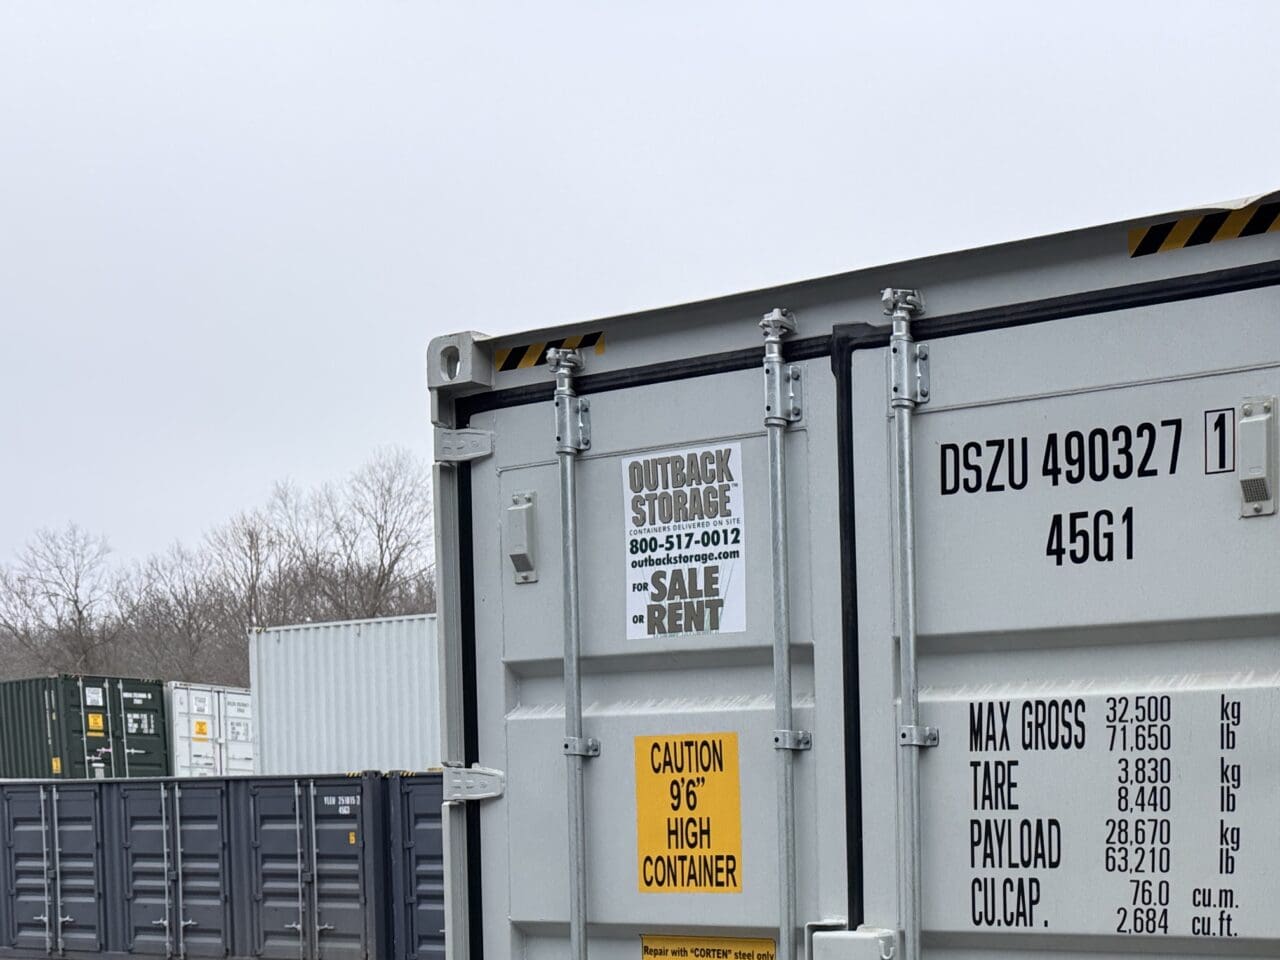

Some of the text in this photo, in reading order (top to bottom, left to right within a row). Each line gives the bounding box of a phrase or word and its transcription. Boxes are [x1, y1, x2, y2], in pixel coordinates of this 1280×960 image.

[940, 413, 1227, 496] DSZU 490327 1
[628, 448, 734, 494] OUTBACK
[631, 483, 732, 528] STORAGE
[629, 525, 671, 536] CONTAINERS
[673, 521, 710, 531] DELIVERED
[629, 528, 741, 555] 800-517-0012
[1046, 506, 1133, 566] 45G1
[631, 550, 740, 568] outbackstorage.com
[632, 565, 720, 602] FOR SALE
[632, 598, 724, 635] OR RENT
[969, 694, 1241, 752] MAX GROSS 32,500 kg
[1106, 723, 1236, 751] 71,650 lb
[650, 740, 724, 773] CAUTION
[970, 757, 1241, 810] TARE 3,830 kg
[1118, 786, 1236, 813] 8,440 lb
[667, 817, 711, 849] HIGH
[970, 819, 1240, 869] PAYLOAD 28,670 kg
[643, 855, 737, 887] CONTAINER
[1105, 847, 1235, 875] 63,210 lb
[1129, 880, 1169, 906] 76.0
[1192, 888, 1239, 908] cu.m.
[1116, 907, 1238, 937] 2,684 cu.ft.
[643, 946, 668, 958] Repair
[671, 947, 688, 957] with
[734, 950, 754, 960] steel
